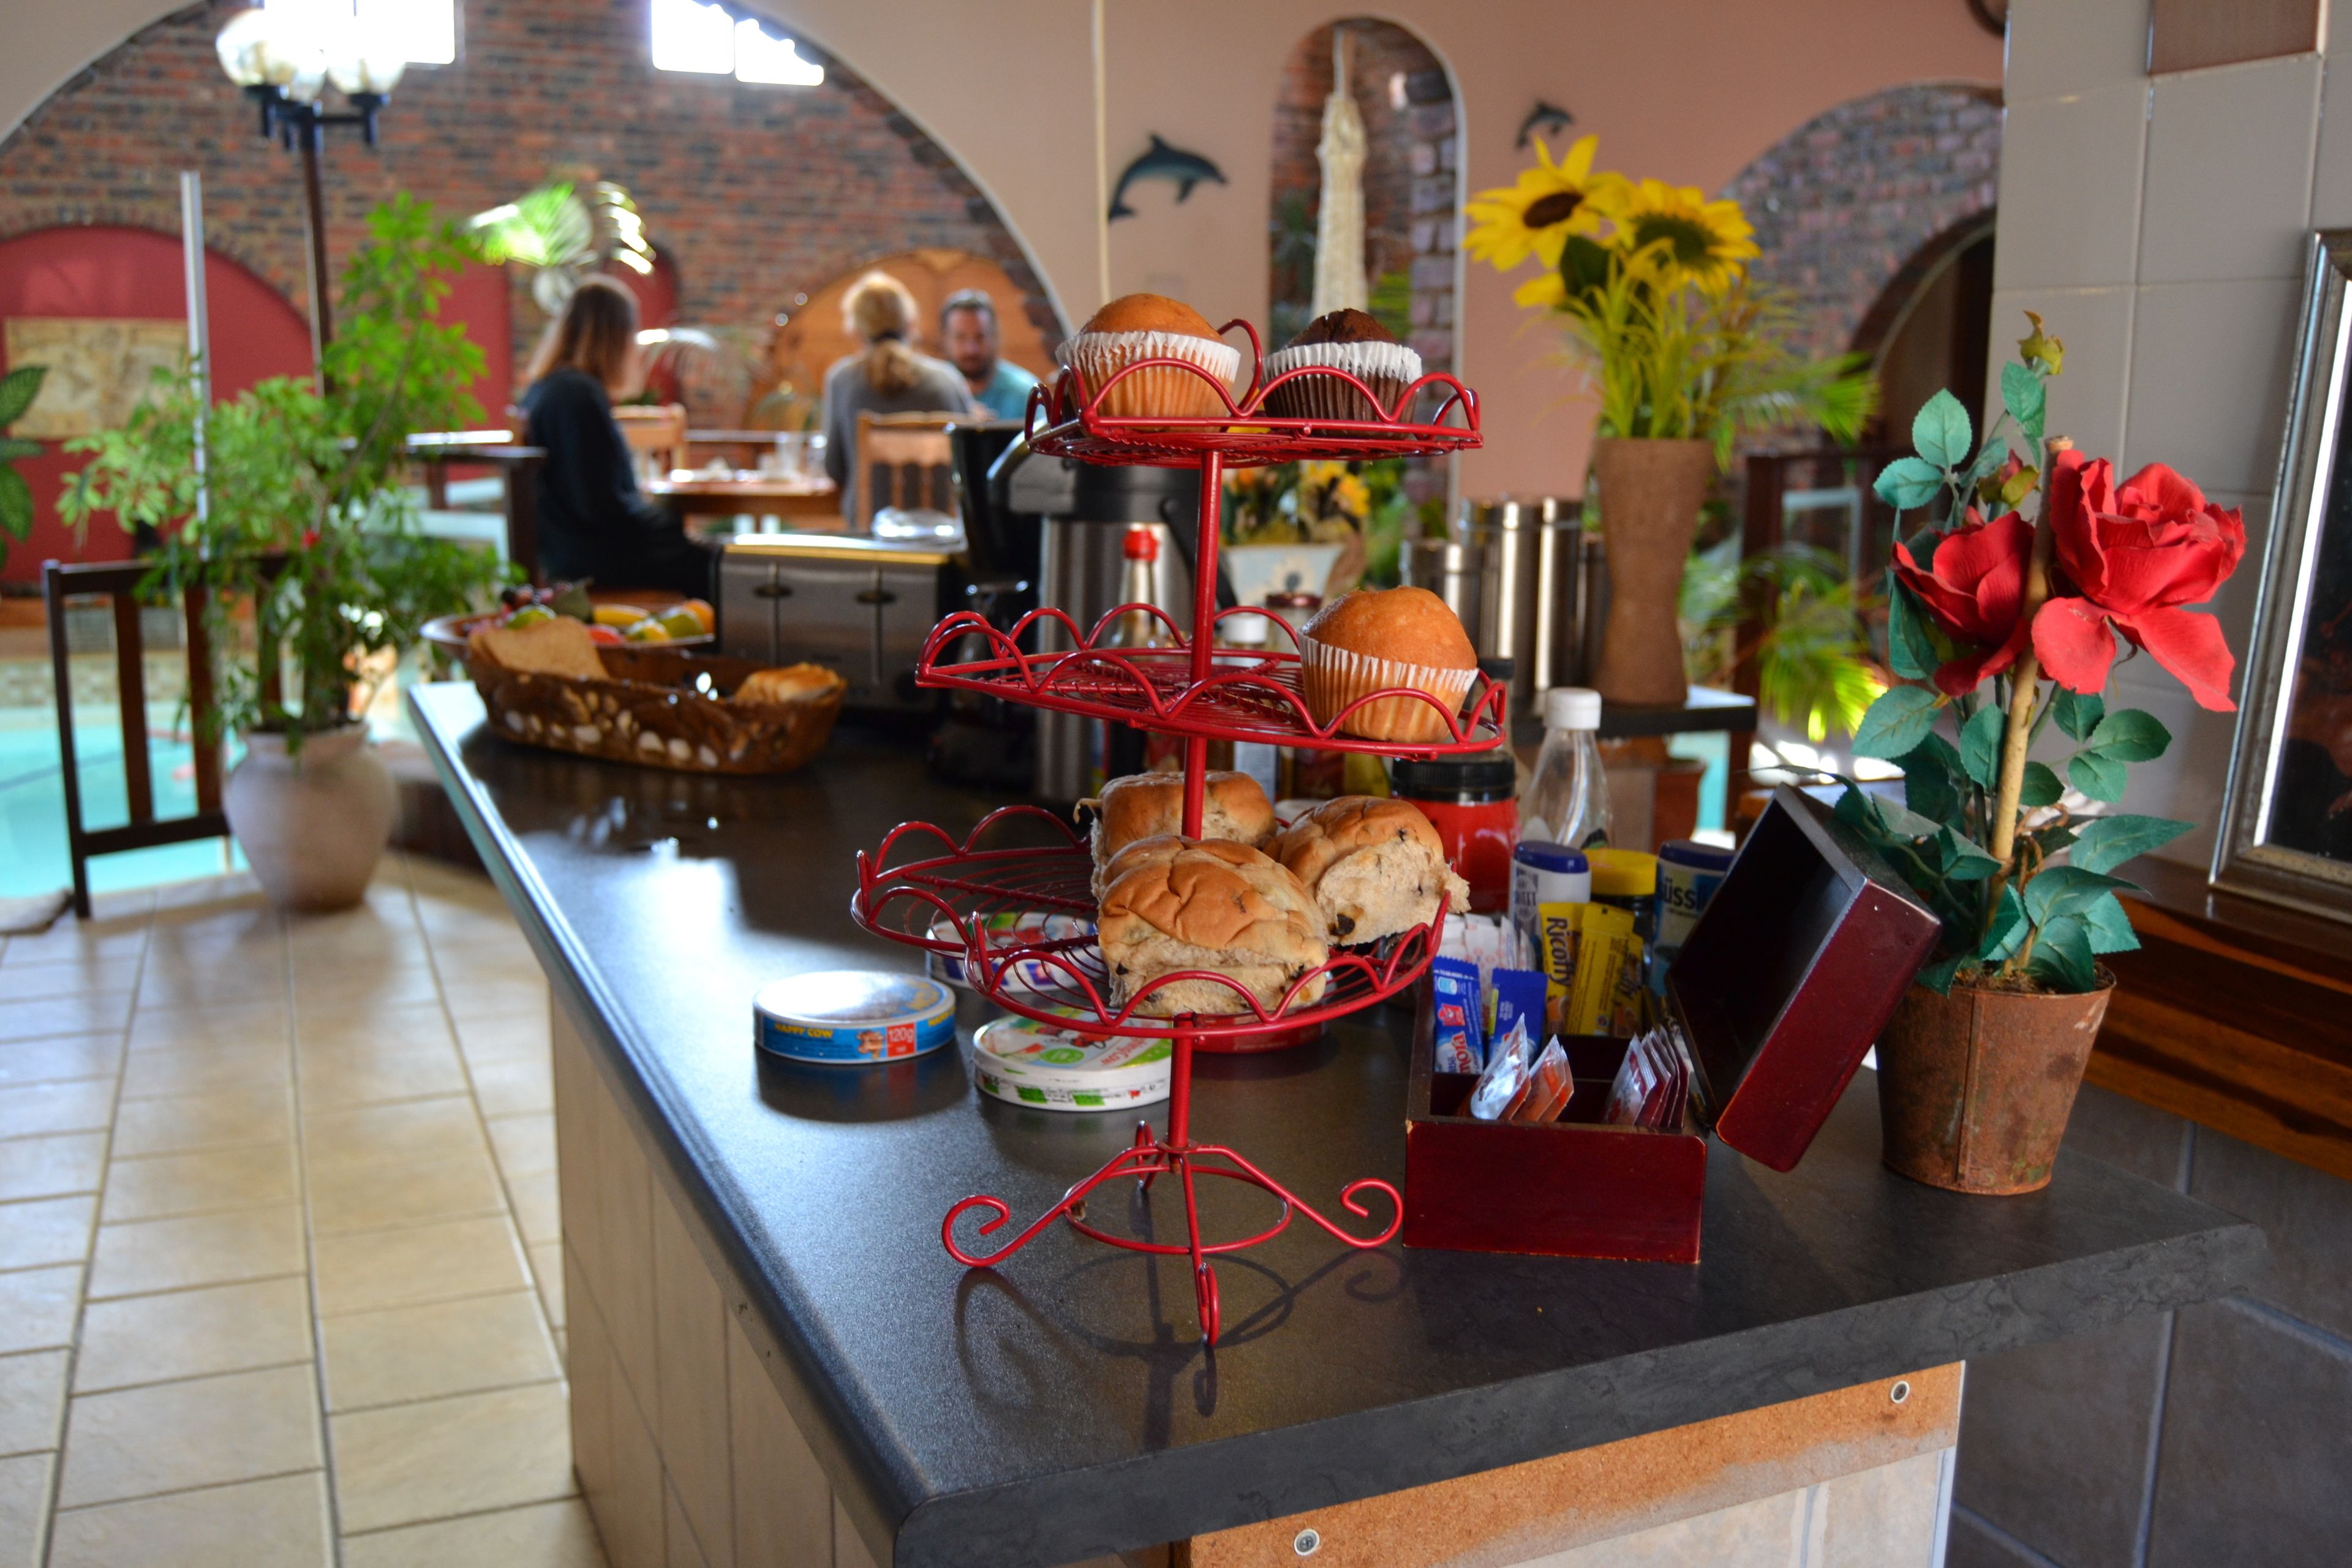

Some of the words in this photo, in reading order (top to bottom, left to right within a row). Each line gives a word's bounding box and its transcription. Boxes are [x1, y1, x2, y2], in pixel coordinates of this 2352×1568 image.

[775, 1023, 805, 1035] HAPPY
[807, 1028, 833, 1039] COW
[889, 1027, 914, 1042] 120g
